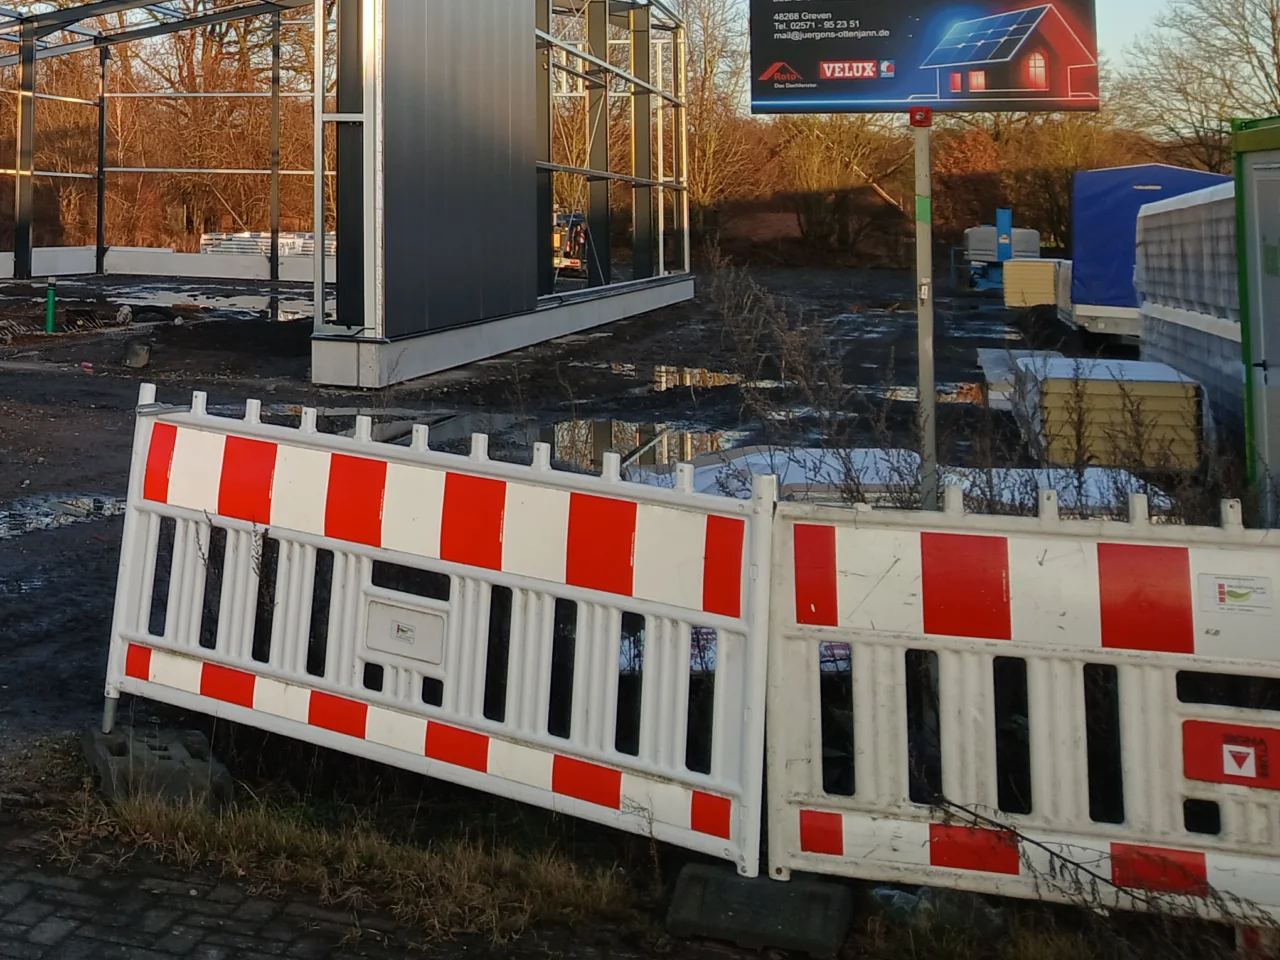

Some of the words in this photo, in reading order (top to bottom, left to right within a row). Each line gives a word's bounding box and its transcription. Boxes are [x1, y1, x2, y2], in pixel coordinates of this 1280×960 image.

[801, 12, 832, 20] Greven
[773, 22, 788, 30] Tel.
[790, 21, 815, 29] 02571
[849, 20, 860, 28] 51
[823, 62, 875, 77] VELUX
[773, 72, 797, 80] Roto
